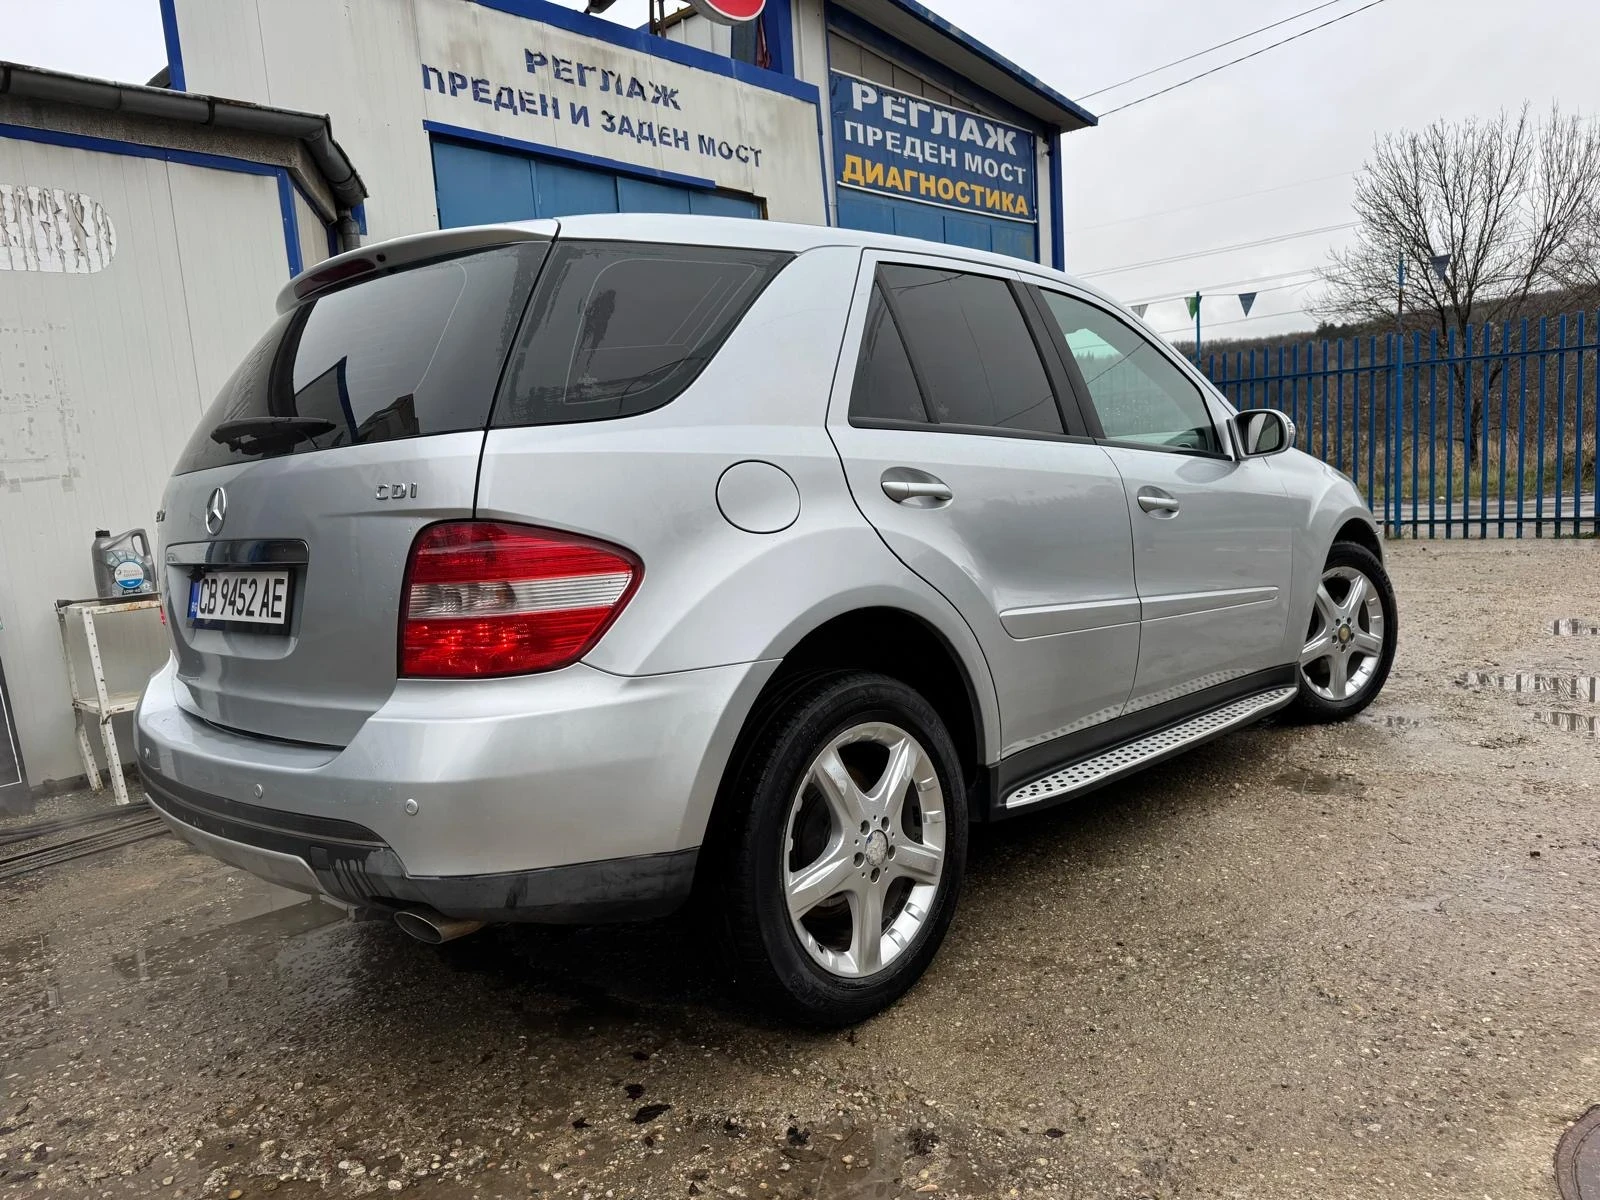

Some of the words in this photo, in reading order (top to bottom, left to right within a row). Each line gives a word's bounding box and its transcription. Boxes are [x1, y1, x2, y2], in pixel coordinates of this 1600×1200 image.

[525, 48, 681, 110] РЕГЛАЖ
[421, 63, 560, 120] ПРЕДЕН
[570, 102, 590, 128] И
[600, 110, 690, 151] ЗАДЕН
[698, 134, 762, 167] МОСТ
[851, 82, 1017, 156] РЕГЛАЖ
[844, 120, 957, 167] ПРЕДЕН
[964, 151, 1026, 185] МОСТ
[842, 154, 1029, 216] ДИАГНОСТИКА
[375, 482, 418, 500] CDI
[220, 578, 258, 616] 9452
